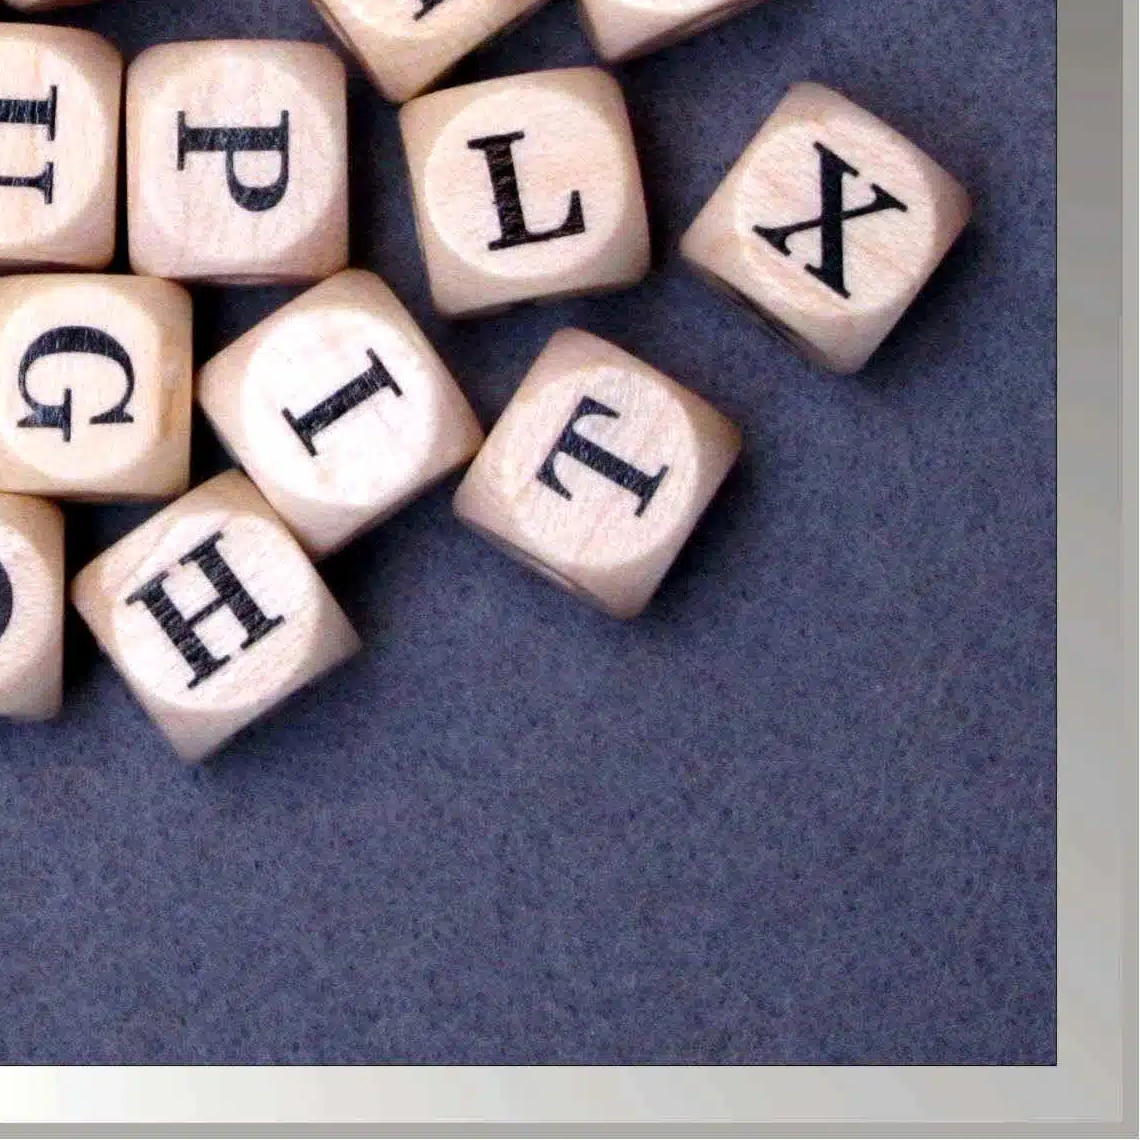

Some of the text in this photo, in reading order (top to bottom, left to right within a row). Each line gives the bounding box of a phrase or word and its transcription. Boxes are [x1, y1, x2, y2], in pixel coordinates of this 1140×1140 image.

[177, 110, 289, 212] P
[467, 131, 586, 251] L
[752, 142, 908, 299] X
[18, 326, 134, 442] G
[282, 349, 402, 457] I
[536, 396, 669, 517] T
[126, 531, 284, 689] H
